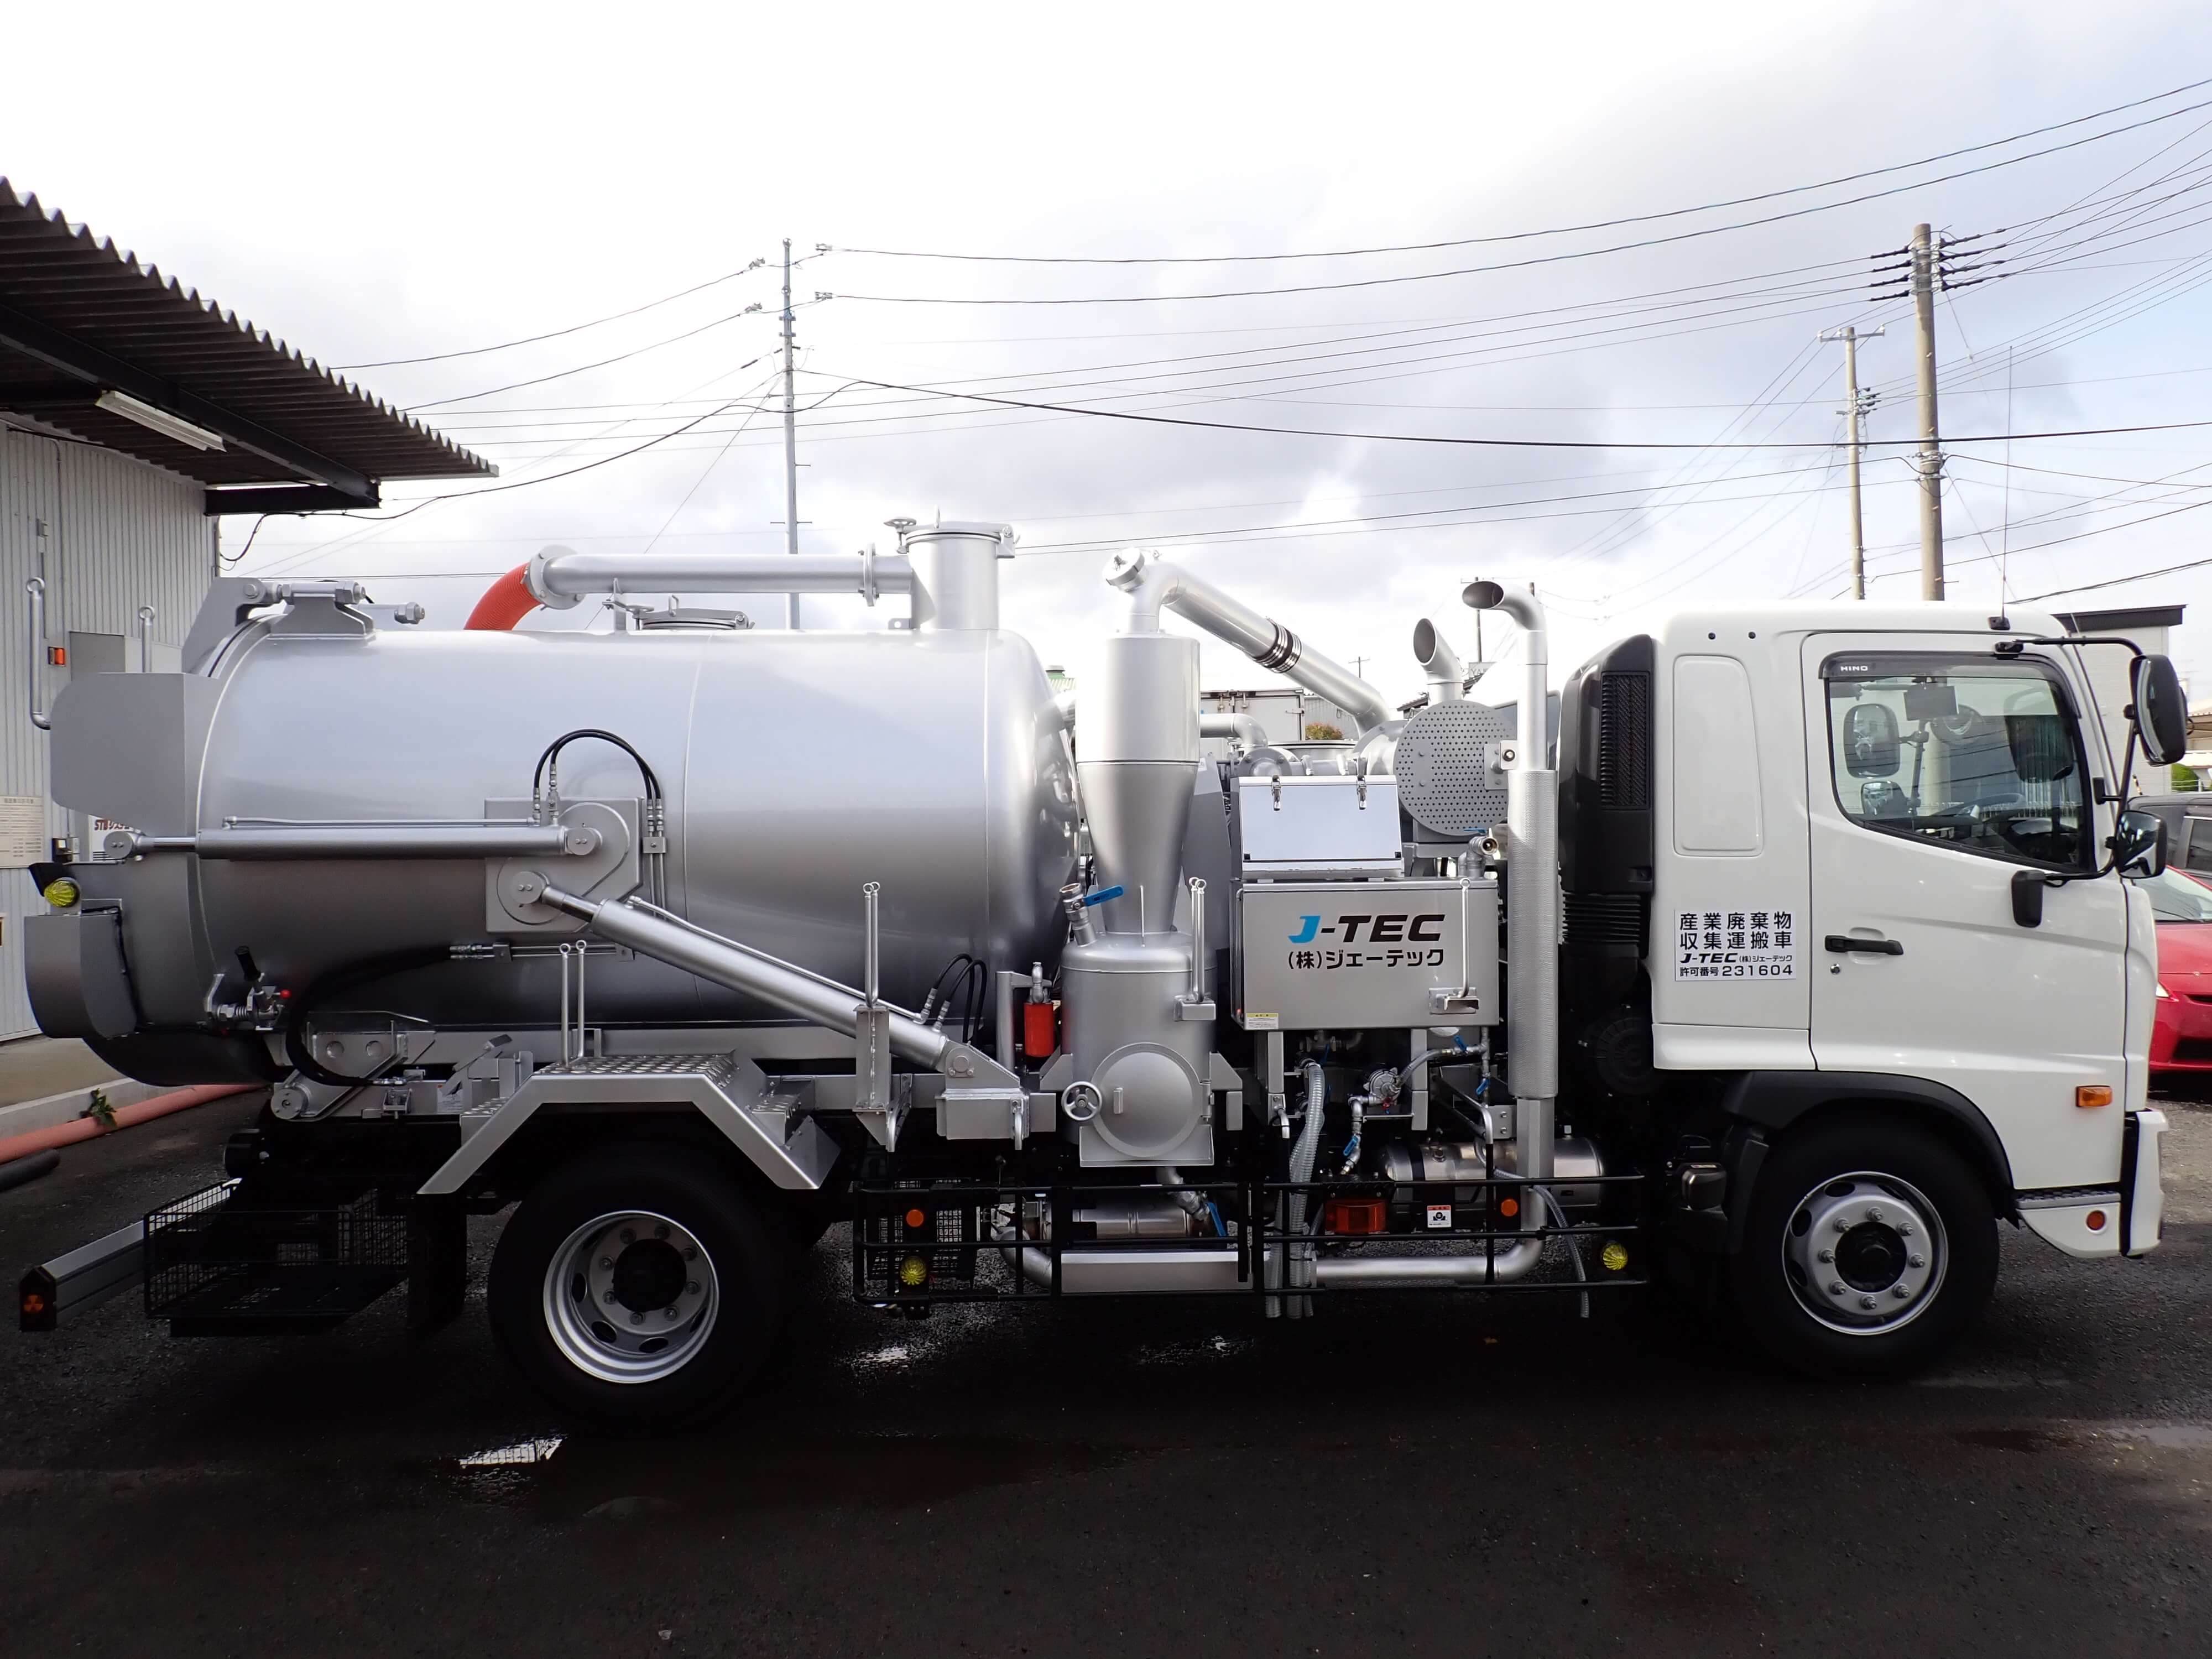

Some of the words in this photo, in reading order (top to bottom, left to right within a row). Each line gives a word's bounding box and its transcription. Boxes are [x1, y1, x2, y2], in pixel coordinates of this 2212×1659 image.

[1288, 914, 1445, 943] J-TEC
[1679, 911, 1792, 931] 産業廃棄物
[1679, 931, 1792, 950] 収集運搬車
[1288, 949, 1444, 969] (株)ジェーテック
[1680, 953, 1738, 963] J-TEC
[1680, 967, 1719, 977] 許可番号
[1722, 964, 1793, 977] 231604
